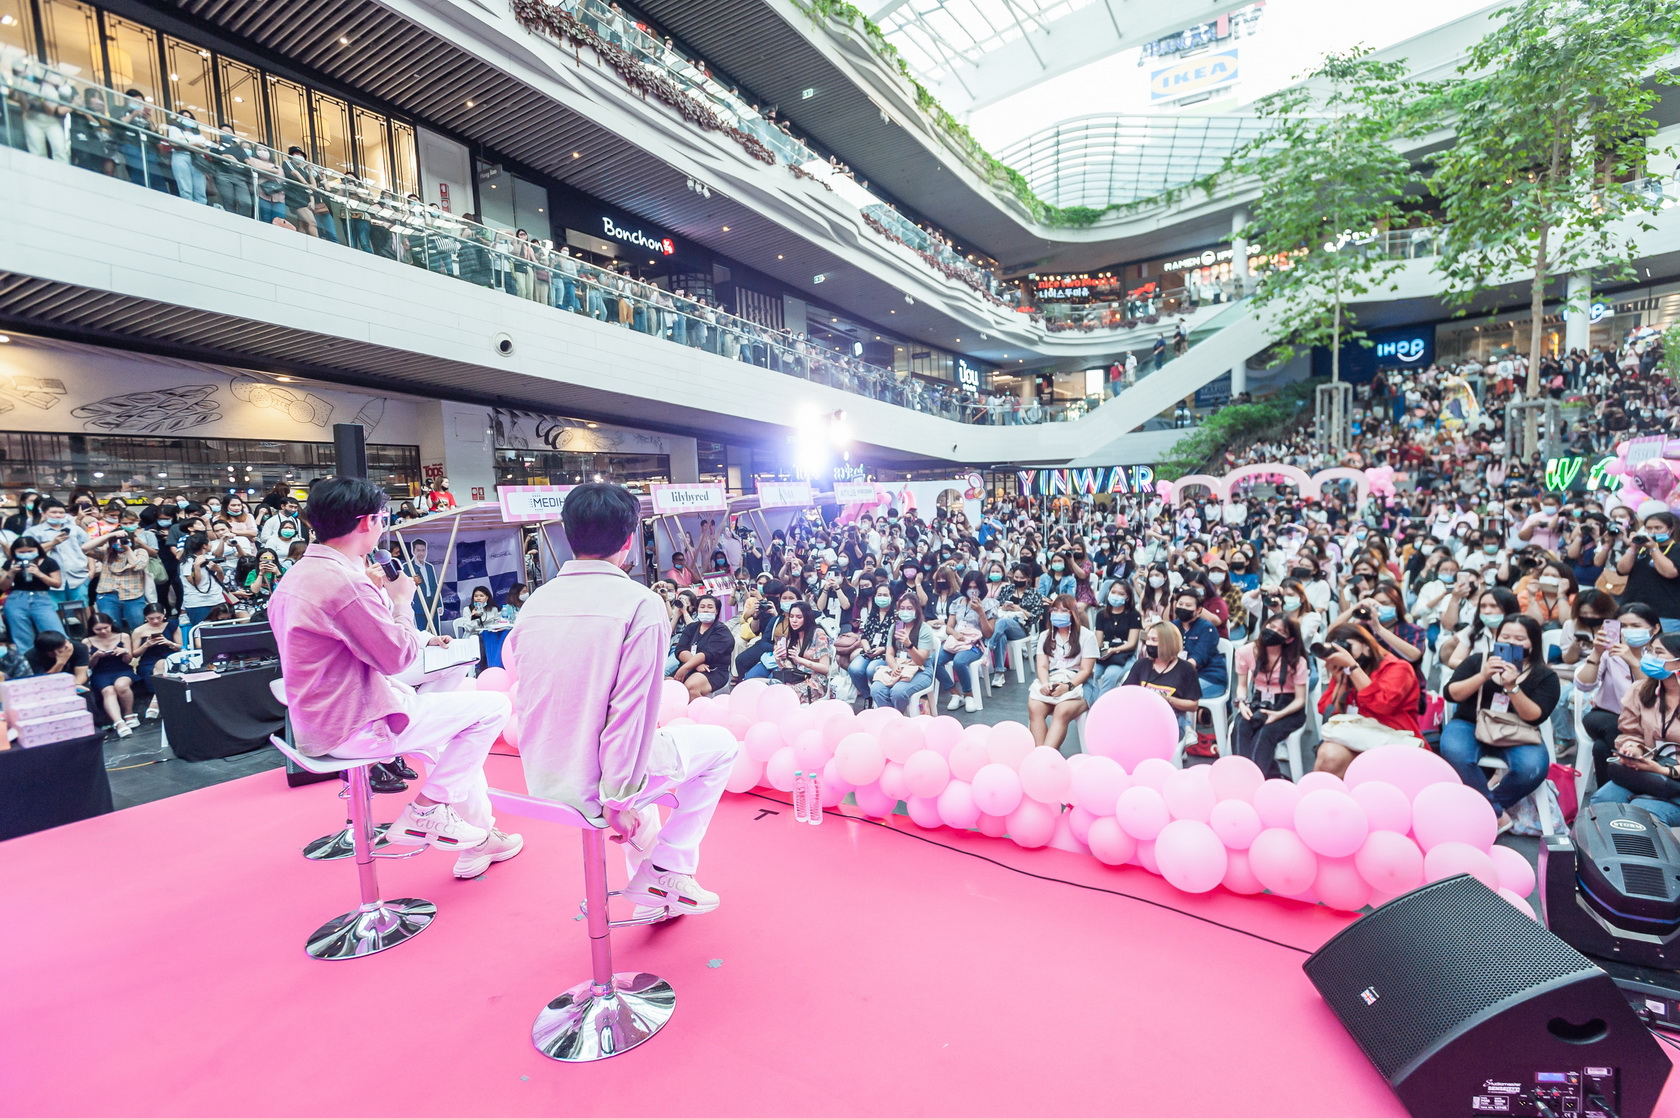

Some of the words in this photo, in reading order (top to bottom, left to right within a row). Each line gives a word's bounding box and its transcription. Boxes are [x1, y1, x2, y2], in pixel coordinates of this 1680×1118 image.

[1162, 62, 1228, 88] IKEA
[602, 216, 664, 252] Bonchon
[1163, 256, 1201, 272] RAMEN
[1376, 338, 1425, 358] IHOP
[423, 465, 444, 481] Tops
[532, 497, 566, 508] MEDIH
[671, 490, 709, 505] lilybyred
[1612, 822, 1645, 830] STORM
